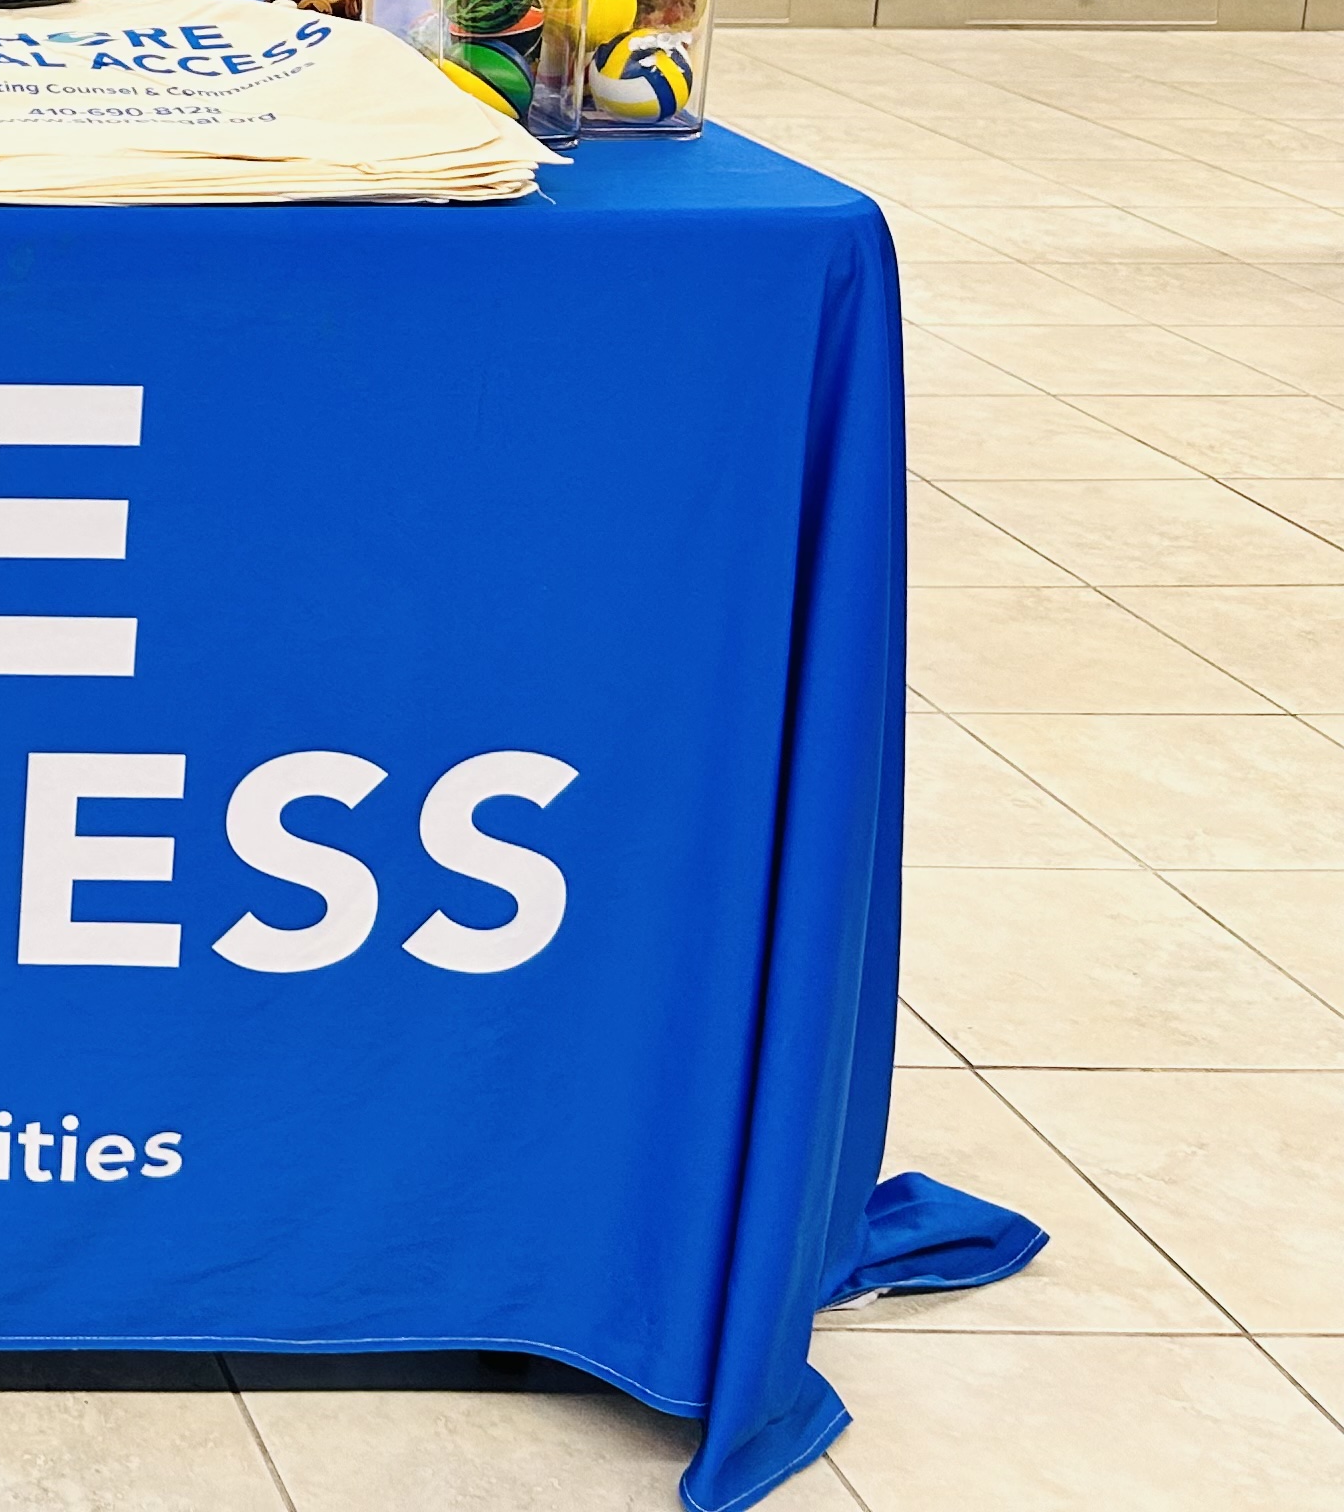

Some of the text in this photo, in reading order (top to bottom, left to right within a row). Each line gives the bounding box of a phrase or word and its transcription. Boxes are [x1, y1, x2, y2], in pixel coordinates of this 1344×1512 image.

[89, 18, 333, 78] ACCESS
[46, 83, 139, 96] Counsel
[145, 87, 160, 97] &
[166, 61, 316, 97] Communities
